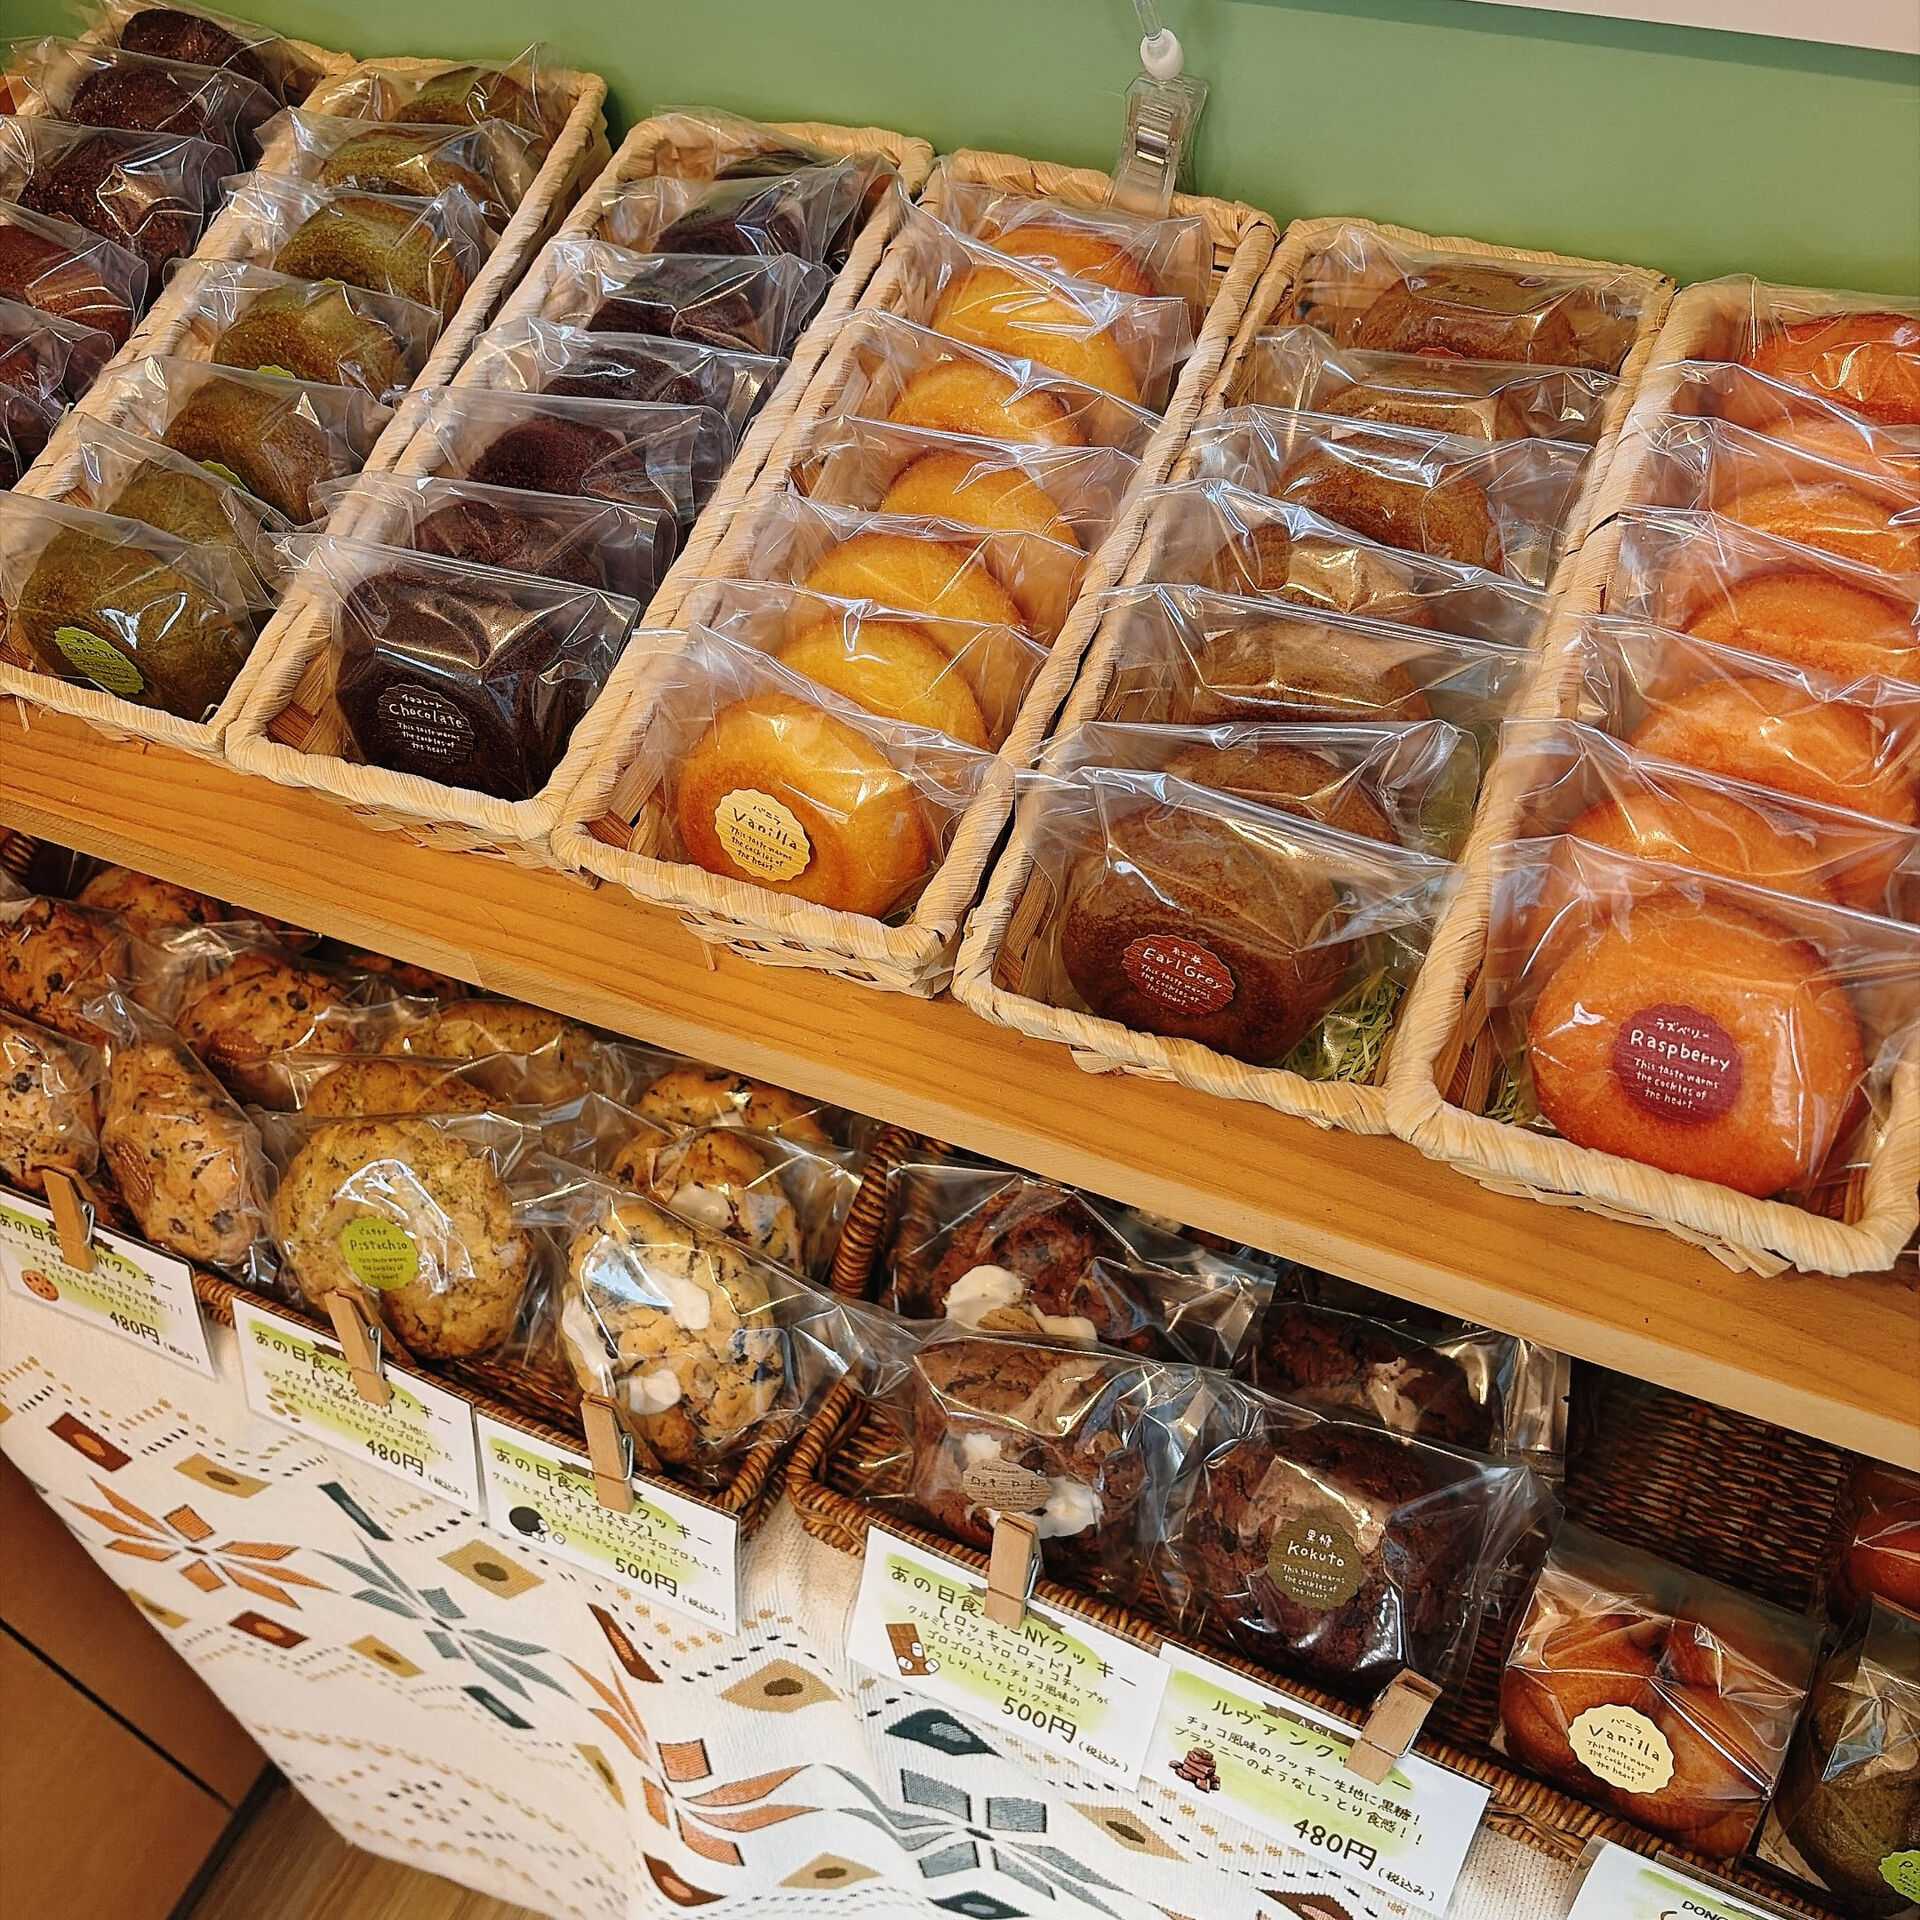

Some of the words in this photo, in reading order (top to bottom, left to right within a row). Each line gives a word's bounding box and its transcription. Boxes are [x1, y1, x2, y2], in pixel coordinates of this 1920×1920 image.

[388, 703, 463, 729] Chocolate
[396, 721, 414, 731] This
[411, 741, 424, 751] the
[733, 807, 797, 850] Vanilla
[752, 805, 781, 825] バニラ
[730, 825, 746, 839] This
[737, 849, 750, 860] the
[1142, 947, 1180, 970] Earl
[1184, 965, 1223, 990] Grey
[1171, 946, 1202, 966] 紅茶
[1140, 963, 1158, 975] This
[1160, 972, 1183, 986] taste
[1184, 983, 1211, 1000] warms
[1145, 982, 1159, 994] the
[1656, 1017, 1709, 1039] ラズベリー
[1630, 1029, 1730, 1072] Raspberry
[1634, 1057, 1655, 1071] This
[1658, 1065, 1684, 1080] taste
[1687, 1073, 1719, 1089] warms
[1636, 1071, 1652, 1083] the
[1655, 1078, 1693, 1097] cockles
[1696, 1090, 1707, 1101] of
[1645, 1087, 1660, 1100] the
[350, 1239, 408, 1251] Pistachio
[109, 1311, 160, 1345] 480円
[366, 1439, 423, 1476] 480円
[548, 1485, 652, 1536] 【オレオスモア】
[1287, 1540, 1344, 1567] Kokuto
[1305, 1529, 1333, 1548] 黒糖
[615, 1556, 677, 1596] 500円
[1282, 1563, 1298, 1574] This
[1300, 1568, 1320, 1580] taste
[1321, 1573, 1345, 1584] warms
[1284, 1575, 1297, 1584] the
[1329, 1585, 1337, 1593] of
[1292, 1587, 1304, 1595] the
[908, 1605, 1107, 1703] クルミとマシュマロ、チョコチップが
[939, 1605, 1071, 1676] 【ロッキーロード】
[923, 1643, 1075, 1717] ずっしり、しっとりクッキー
[927, 1630, 1079, 1706] ゴロゴロ入ったチョコ風味の
[1001, 1696, 1076, 1743] 500円
[1078, 1741, 1128, 1772] （税込み）
[1611, 1718, 1642, 1735] バニラ
[1586, 1739, 1605, 1750] This
[1607, 1746, 1628, 1760] taste
[1630, 1757, 1655, 1774] warms
[1588, 1724, 1660, 1762] Vanilla
[1188, 1716, 1418, 1824] チョコ風味のクッキー生地に黒糖！
[1589, 1749, 1602, 1758] the
[1604, 1755, 1635, 1774] cockles
[1637, 1771, 1646, 1779] of
[1596, 1760, 1610, 1771] the
[1175, 1727, 1421, 1844] ブラウニーのようなしっとり食感！！
[1293, 1819, 1376, 1870] 480円
[1378, 1867, 1434, 1901] （税込み）
